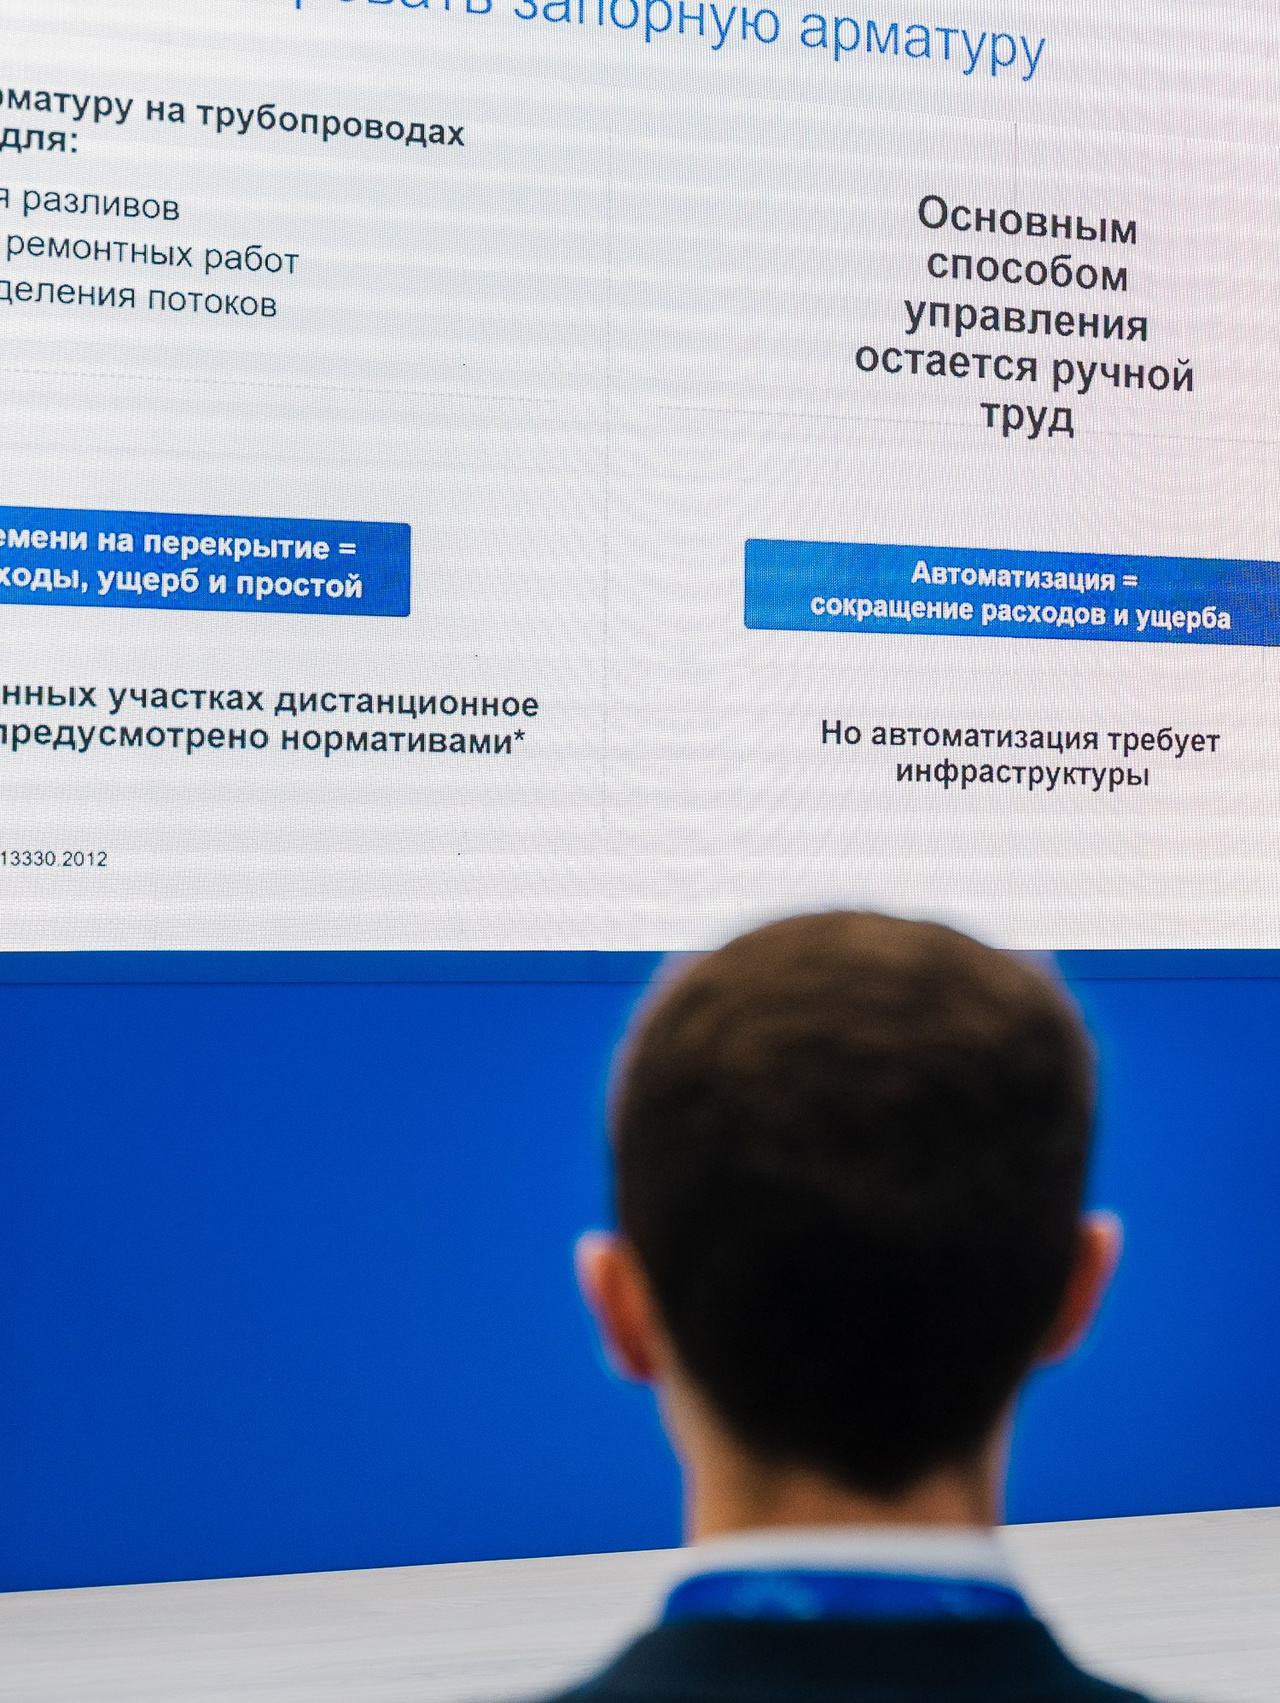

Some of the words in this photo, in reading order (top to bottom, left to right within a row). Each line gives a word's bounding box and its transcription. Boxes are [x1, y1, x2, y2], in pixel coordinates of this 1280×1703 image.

[514, 0, 780, 51] запорную
[800, 13, 1046, 82] арматуру
[0, 88, 133, 125] матуру
[146, 100, 185, 123] на
[196, 103, 465, 148] трубопроводах
[0, 127, 77, 153] для:
[23, 190, 180, 221] разливов
[918, 194, 1137, 245] Основным
[7, 235, 192, 267] ремонтных
[205, 244, 299, 275] работ
[927, 252, 1127, 292] способом
[149, 289, 277, 317] потоков
[904, 300, 1148, 342] управления
[855, 345, 1037, 382] остается
[1053, 358, 1193, 395] ручной
[980, 402, 1075, 440] труд
[98, 532, 134, 552] на
[144, 534, 330, 562] перекрытие
[96, 567, 200, 597] ущерб
[209, 574, 227, 594] и
[237, 573, 363, 601] простой
[911, 560, 1116, 594] Автоматизация
[810, 596, 974, 622] сокращение
[981, 603, 1106, 628] расходов
[1114, 608, 1129, 626] и
[1135, 605, 1231, 634] ущерба
[108, 687, 264, 716] участках
[274, 692, 539, 720] дистанционное
[822, 719, 862, 745] Но
[871, 726, 1098, 754] автоматизация
[1107, 728, 1221, 758] требует
[896, 758, 1149, 793] инфраструктуры
[0, 849, 108, 868] 13330.2012
